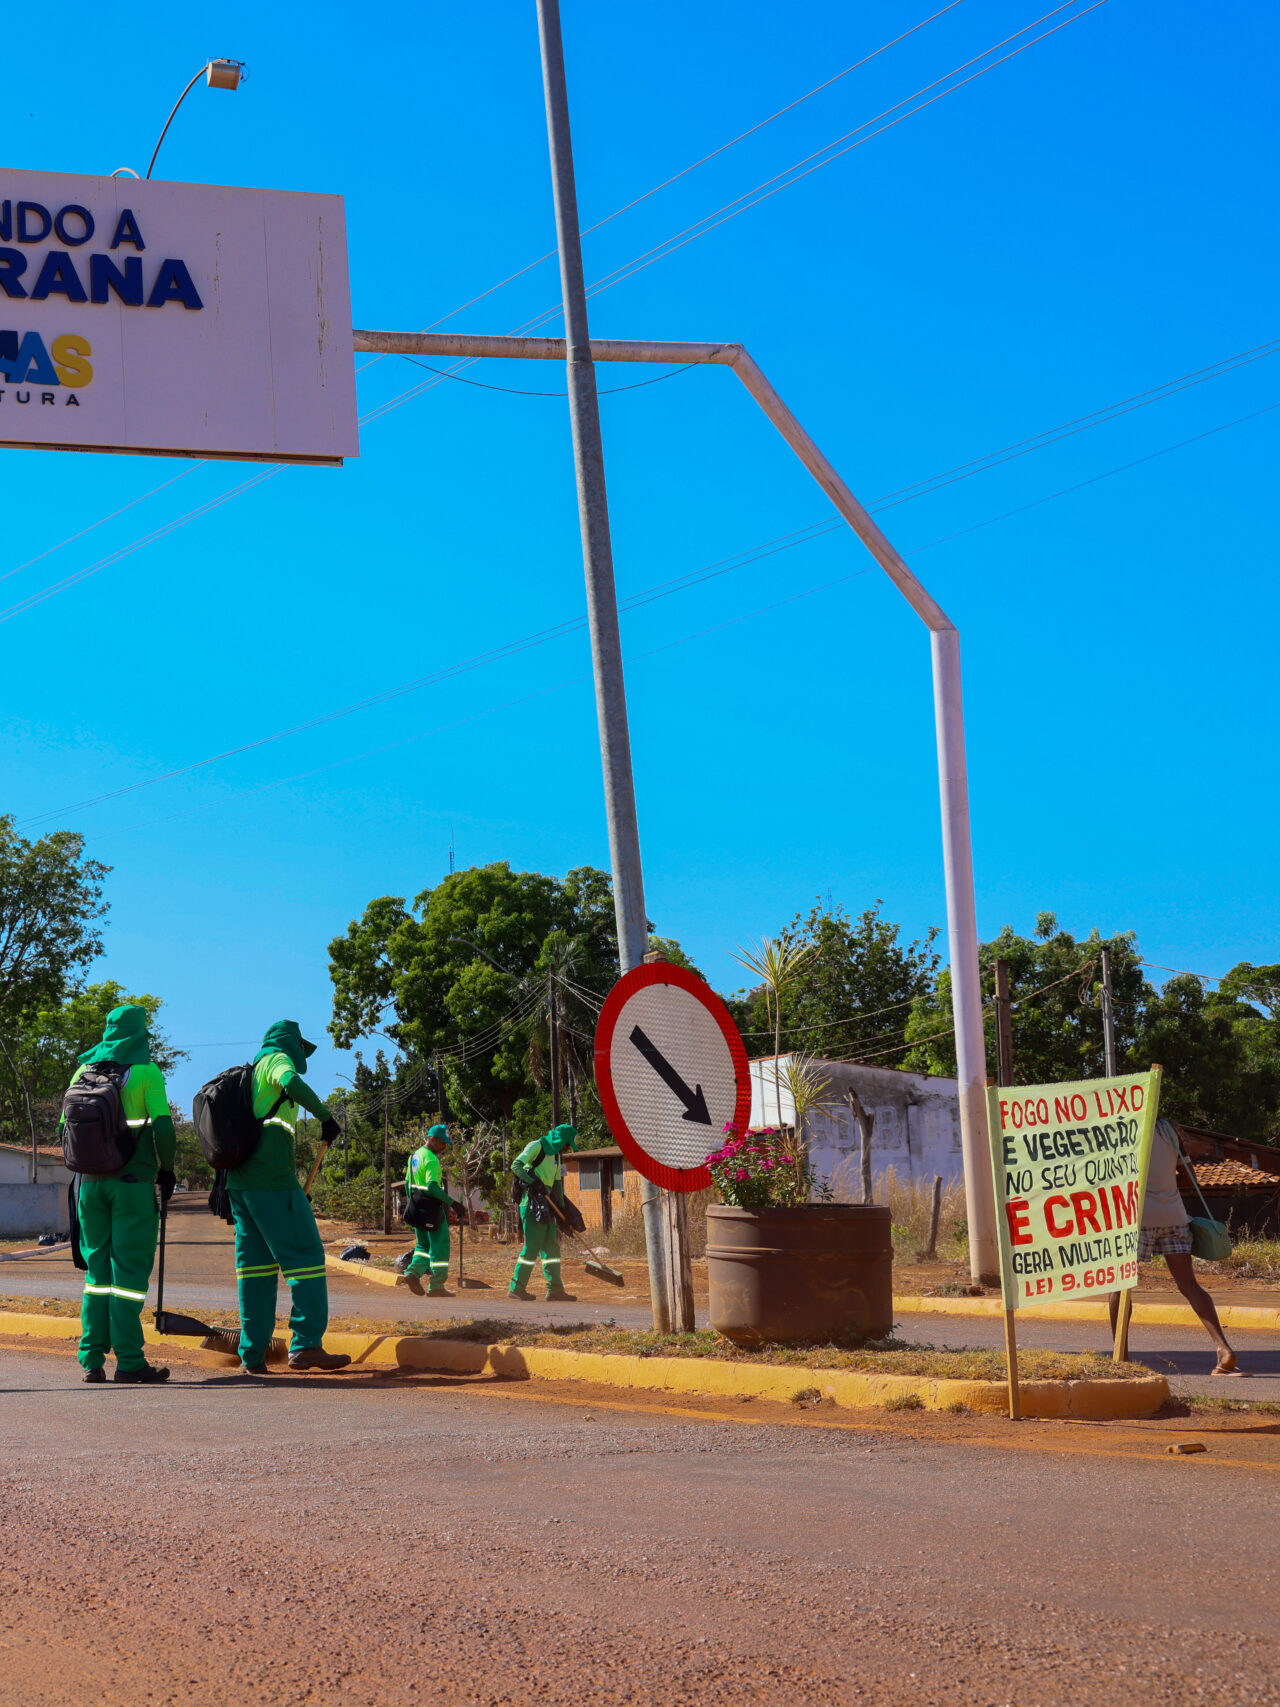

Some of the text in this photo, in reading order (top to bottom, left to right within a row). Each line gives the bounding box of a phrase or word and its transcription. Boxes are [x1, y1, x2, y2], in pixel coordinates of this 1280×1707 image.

[110, 208, 146, 251] A
[1000, 1085, 1144, 1130] FOGO NO LIXO
[1003, 1115, 1138, 1165] E VEGETAÇÃO
[1006, 1169, 1033, 1195] NO
[1041, 1164, 1077, 1191] SEU
[1005, 1196, 1034, 1246] É
[1012, 1247, 1054, 1275] GERA
[1058, 1237, 1112, 1269] MULTA
[1114, 1235, 1123, 1258] E
[1025, 1277, 1053, 1297] LEI
